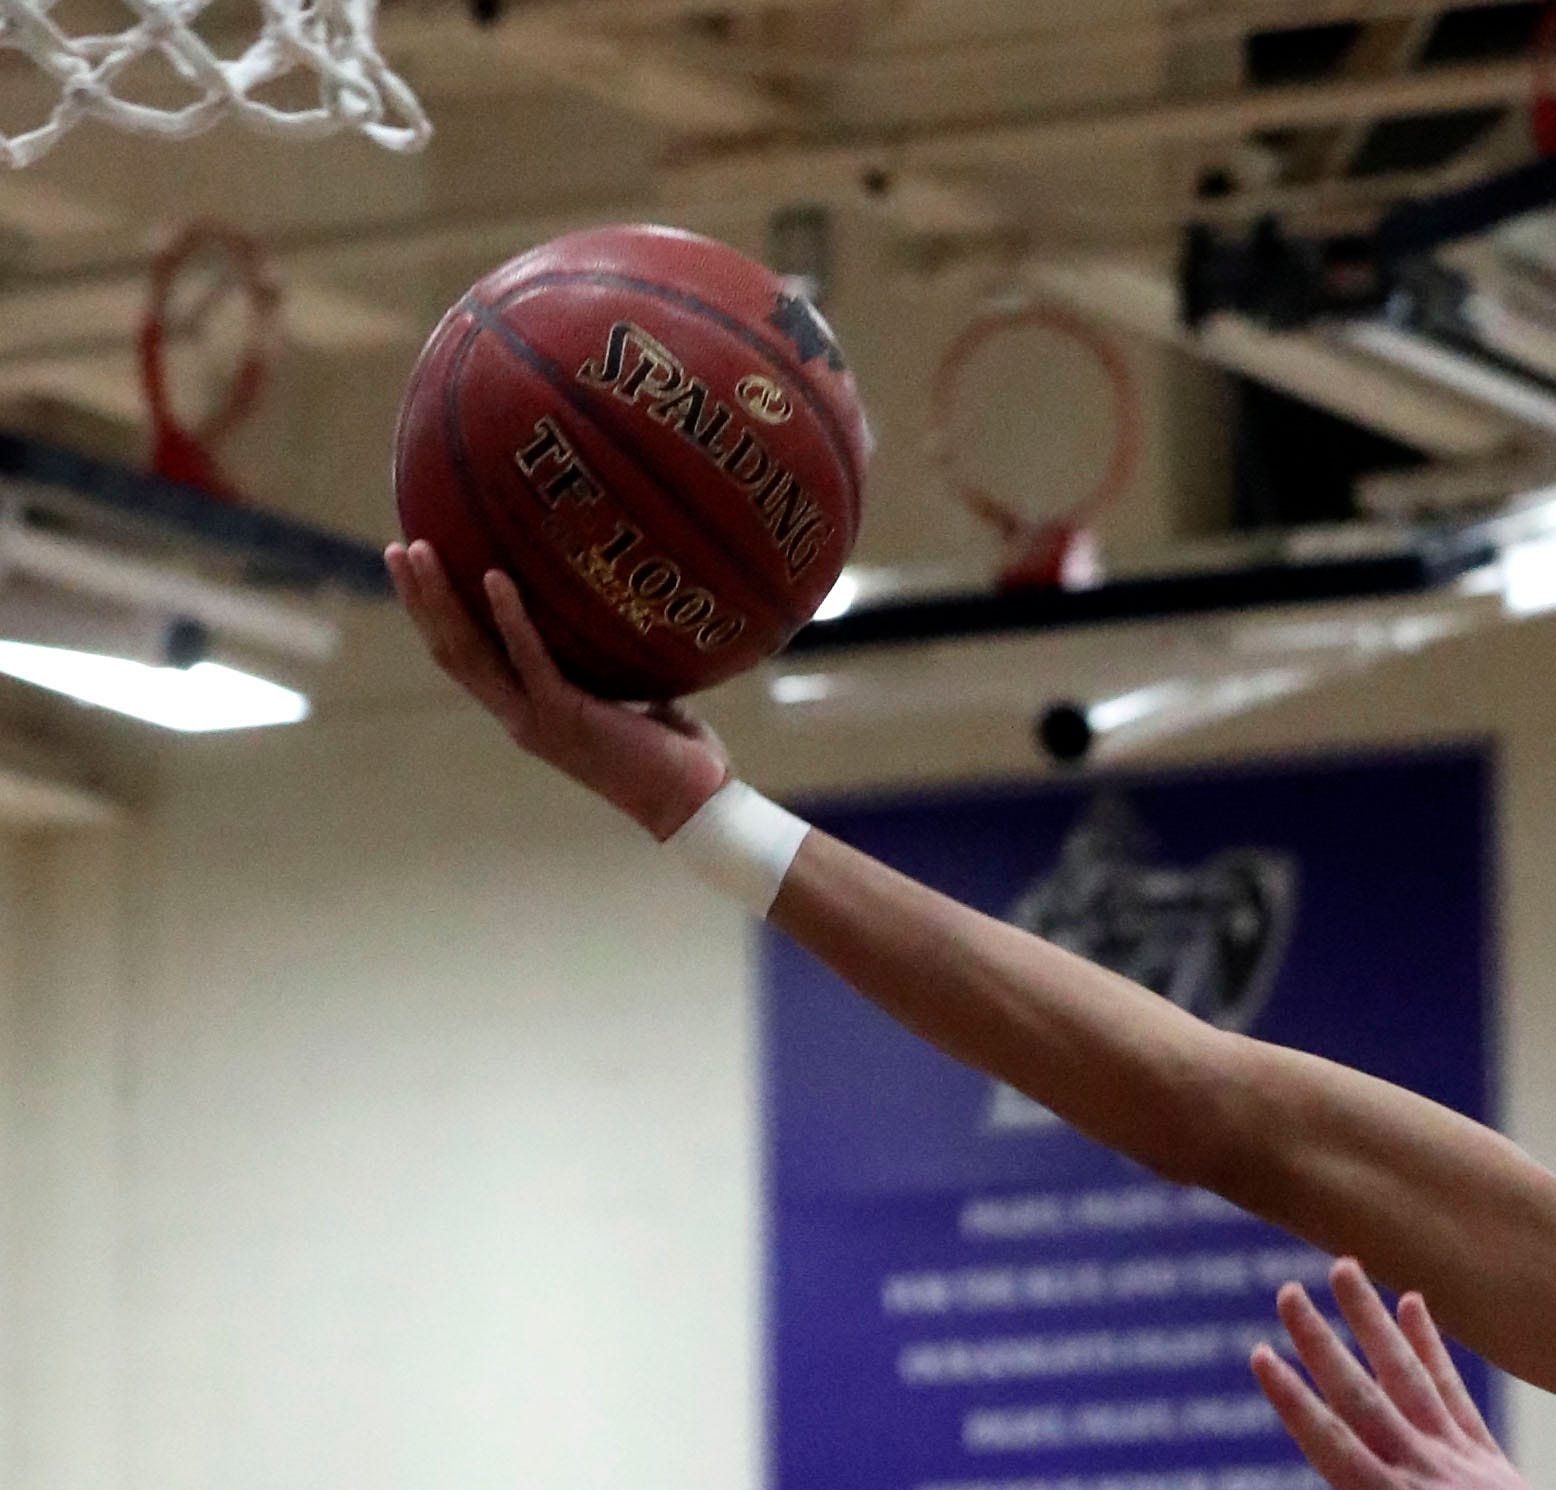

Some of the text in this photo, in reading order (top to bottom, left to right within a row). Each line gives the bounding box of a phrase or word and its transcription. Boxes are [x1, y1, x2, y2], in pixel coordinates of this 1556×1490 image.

[515, 414, 605, 511] TF
[606, 521, 746, 652] 1000
[577, 320, 834, 583] SPALDING
